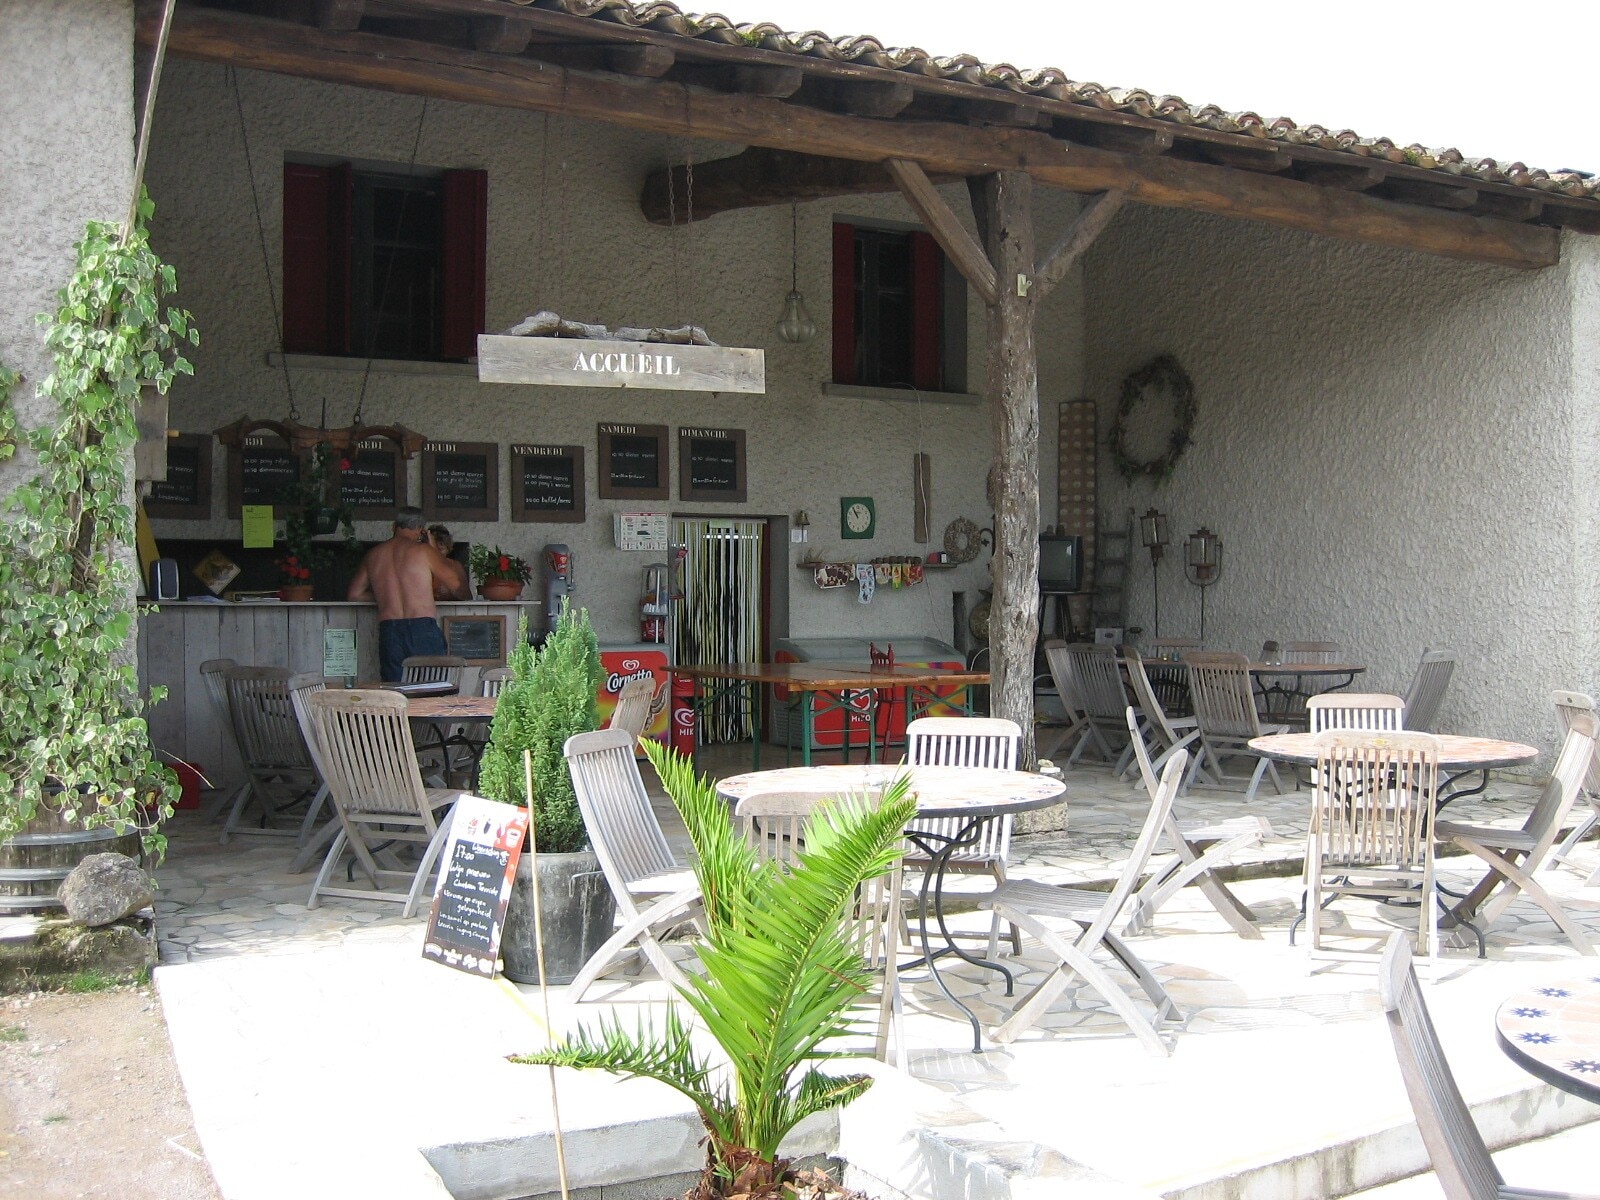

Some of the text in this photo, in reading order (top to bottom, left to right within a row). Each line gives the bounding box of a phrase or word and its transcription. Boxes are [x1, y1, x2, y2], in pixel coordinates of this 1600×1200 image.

[573, 352, 680, 376] ACCUEIL
[600, 425, 636, 434] SAMEDI
[681, 429, 728, 438] DIMANCHE
[245, 437, 263, 446] RDI
[357, 440, 382, 449] REDI
[424, 443, 456, 452] JEUDI
[513, 446, 564, 456] VENDREDI
[606, 669, 653, 693] Cornetto
[679, 728, 694, 736] MIK
